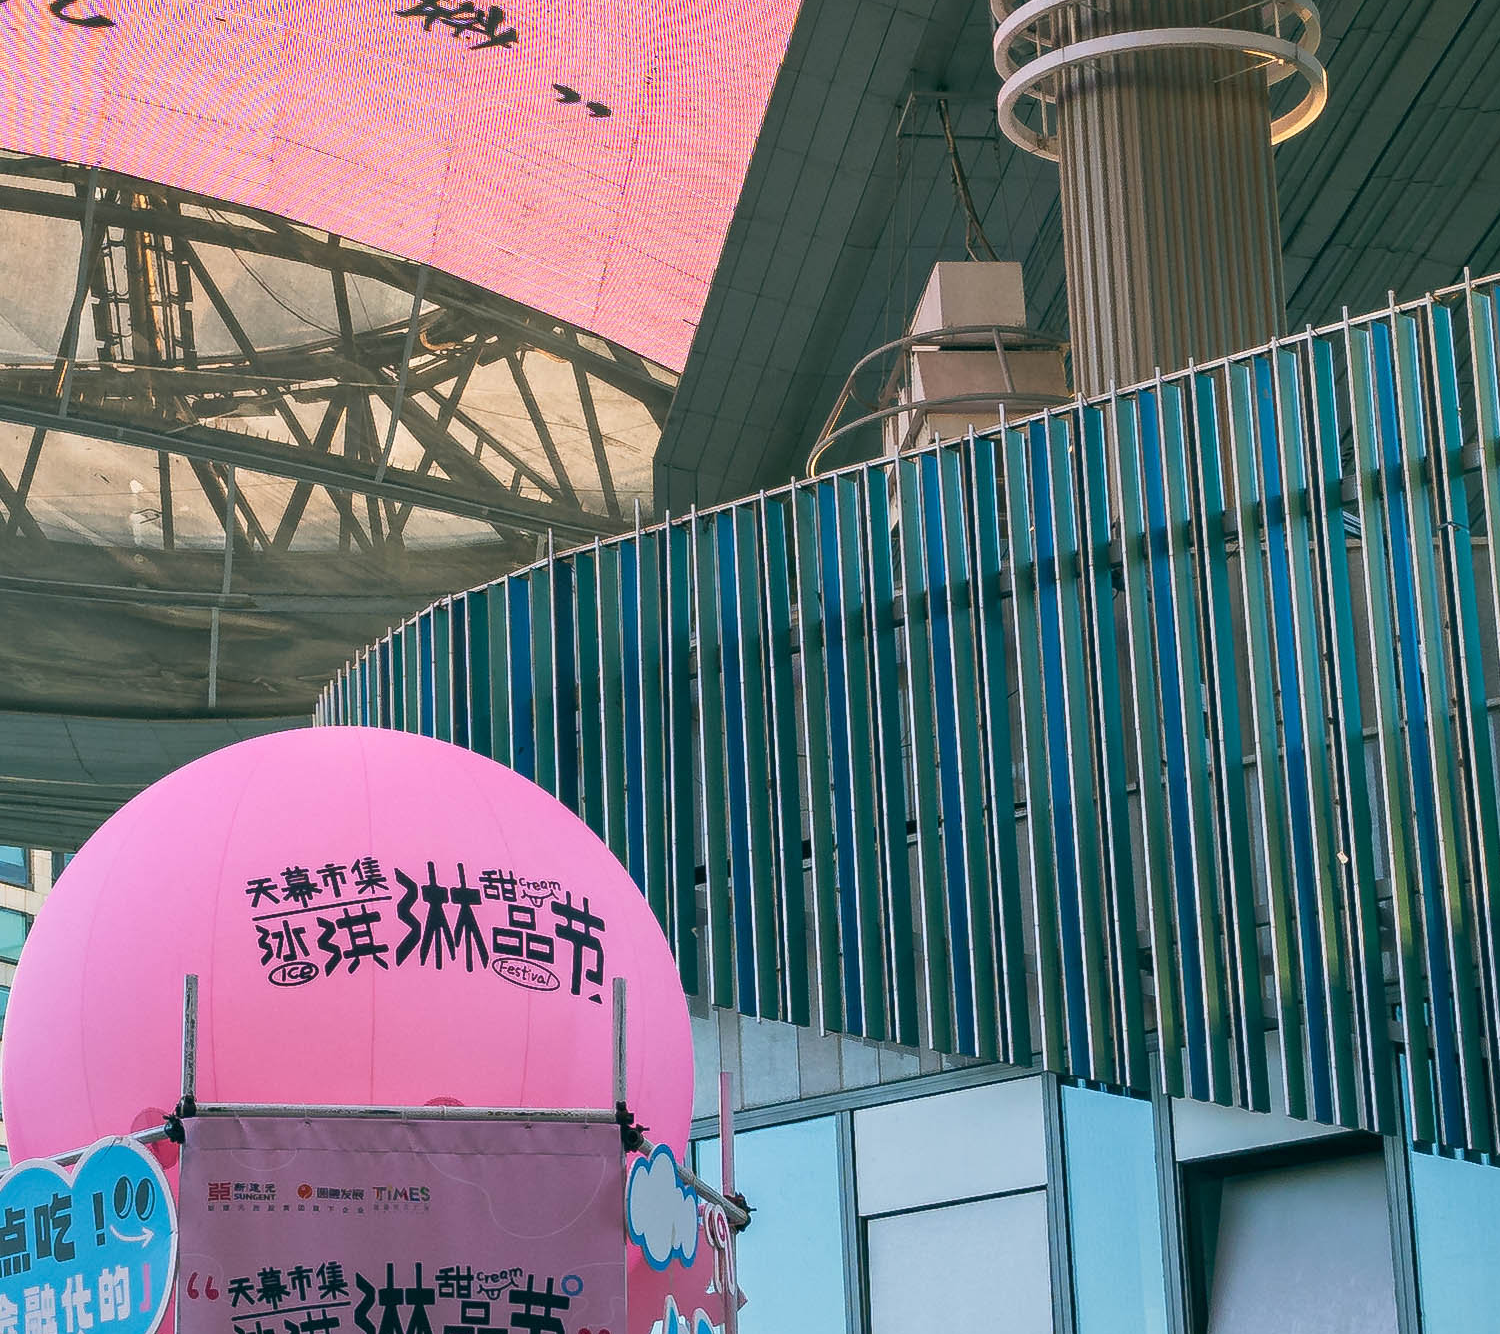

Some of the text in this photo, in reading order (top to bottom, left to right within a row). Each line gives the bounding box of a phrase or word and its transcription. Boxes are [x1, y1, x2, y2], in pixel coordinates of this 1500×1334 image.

[245, 856, 390, 909] 天幕市集
[234, 1193, 276, 1201] SUNGENT
[227, 1261, 349, 1307] 天幕市集
